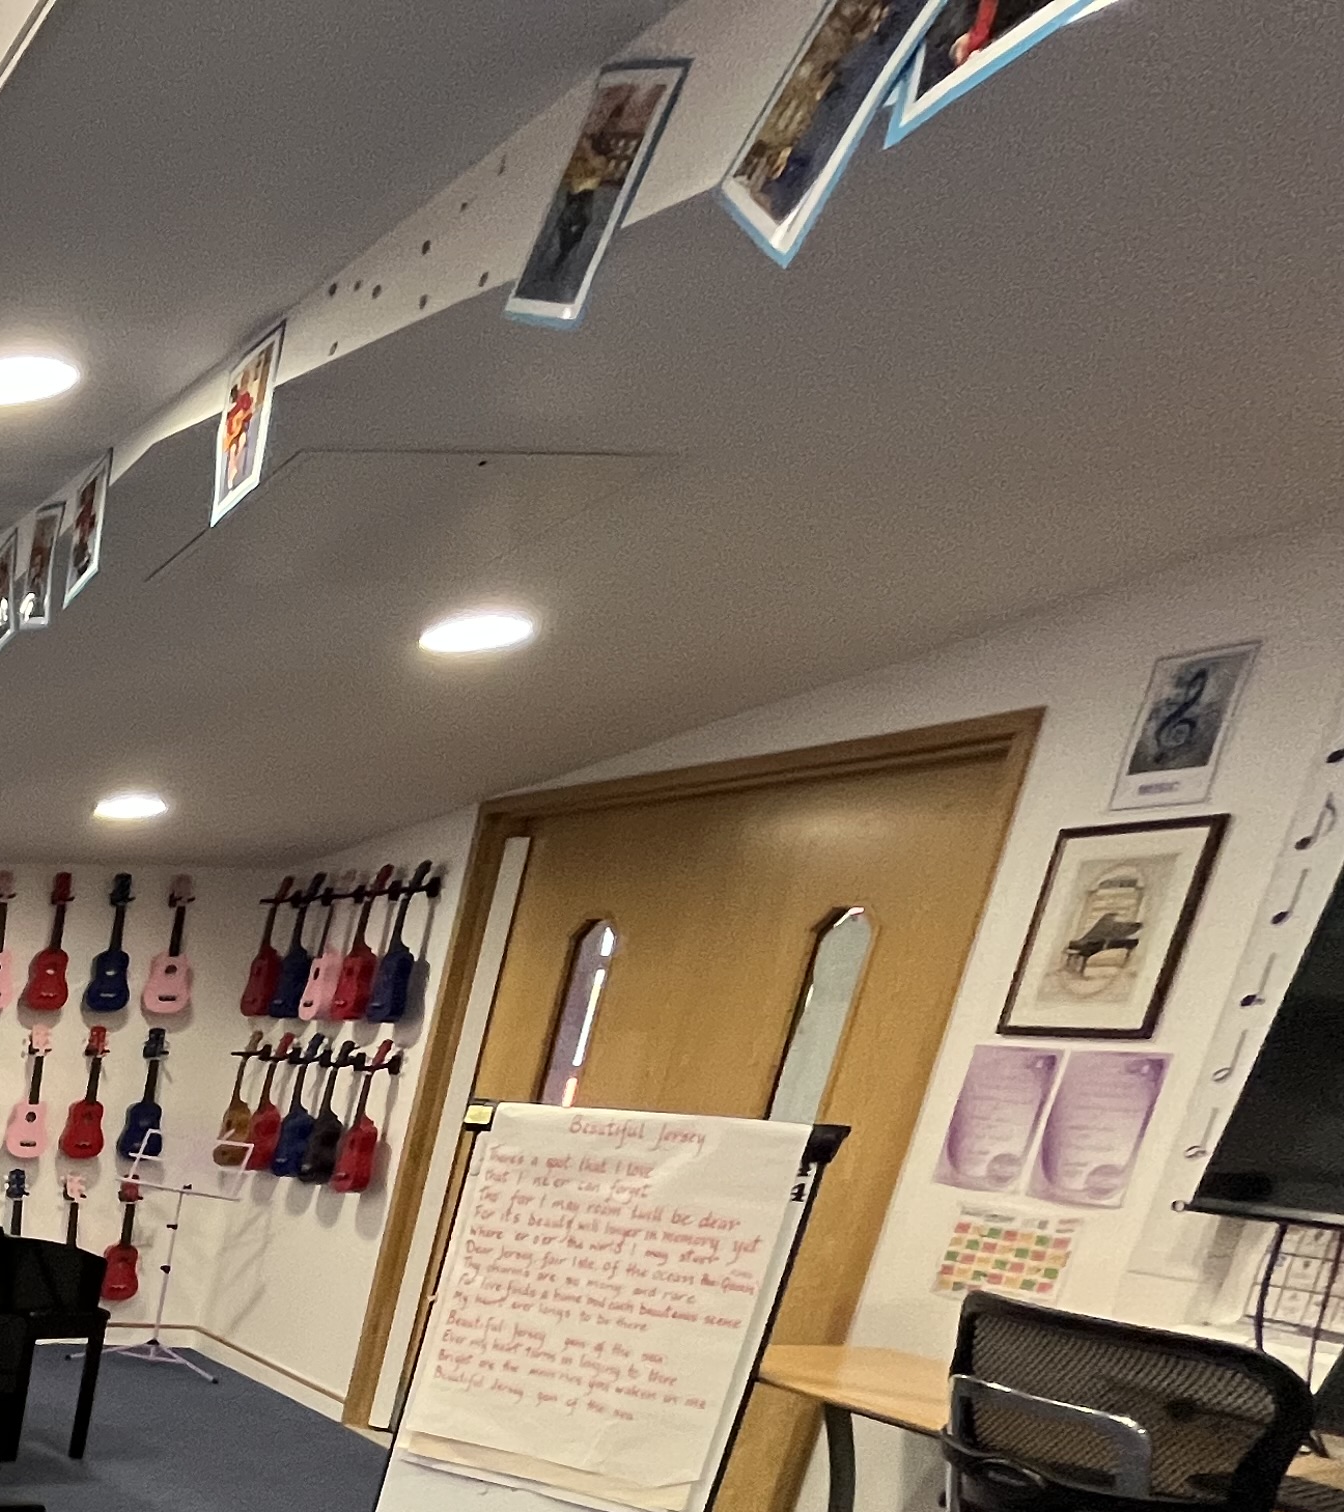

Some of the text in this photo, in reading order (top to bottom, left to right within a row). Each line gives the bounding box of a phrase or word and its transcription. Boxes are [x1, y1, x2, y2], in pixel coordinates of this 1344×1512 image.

[568, 1114, 707, 1158] Beautiful Jersey
[603, 1179, 653, 1205] forget
[670, 1207, 696, 1227] be
[698, 1210, 742, 1232] dear
[660, 1230, 721, 1256] memory
[725, 1234, 764, 1267] yet
[602, 1259, 621, 1281] of
